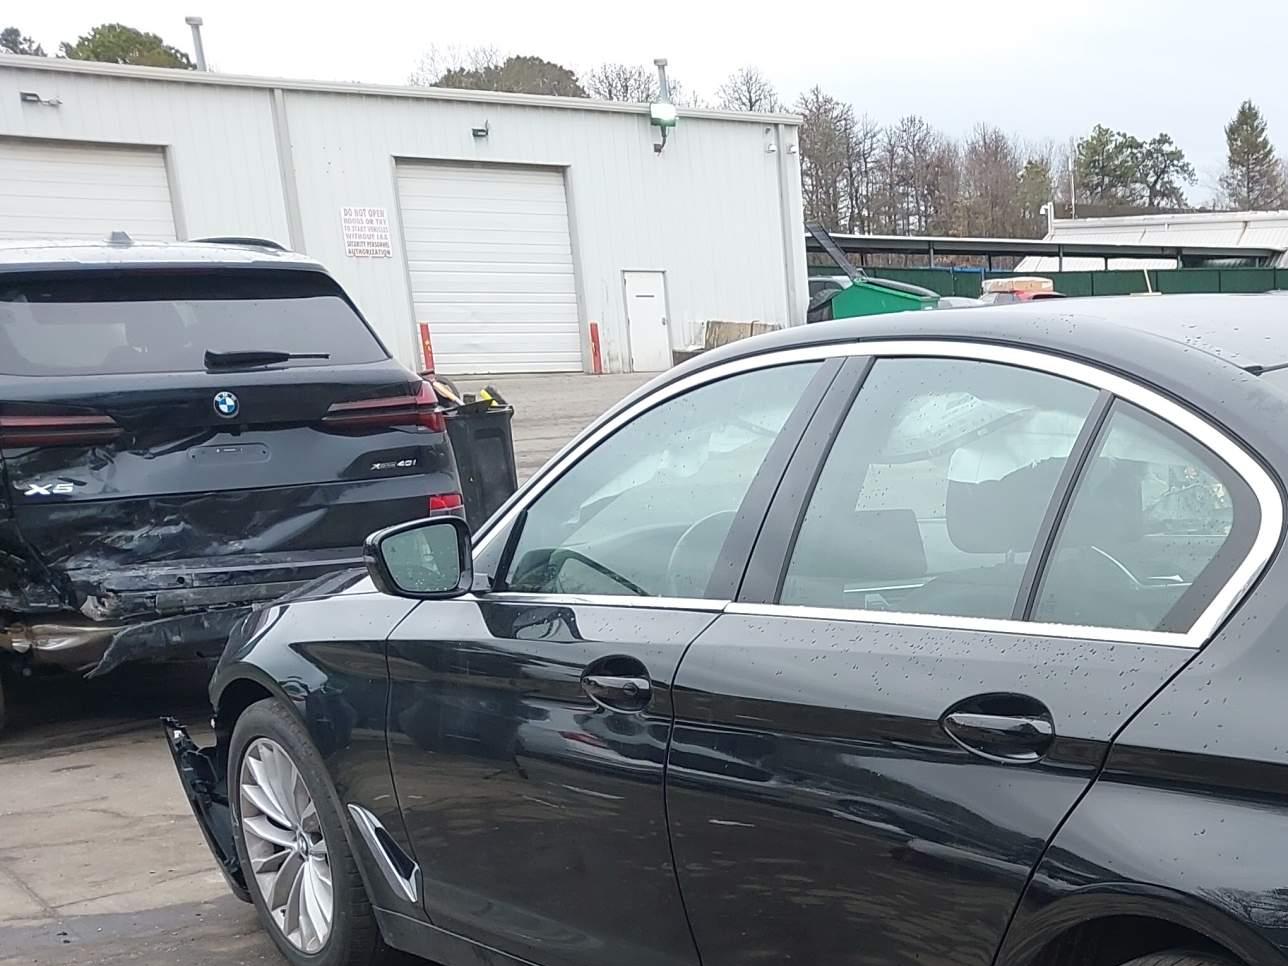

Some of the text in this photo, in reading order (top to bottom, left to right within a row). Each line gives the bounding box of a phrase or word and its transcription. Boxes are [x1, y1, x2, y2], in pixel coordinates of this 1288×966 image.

[344, 208, 384, 218] DO NOT OPEN
[24, 483, 74, 496] X5
